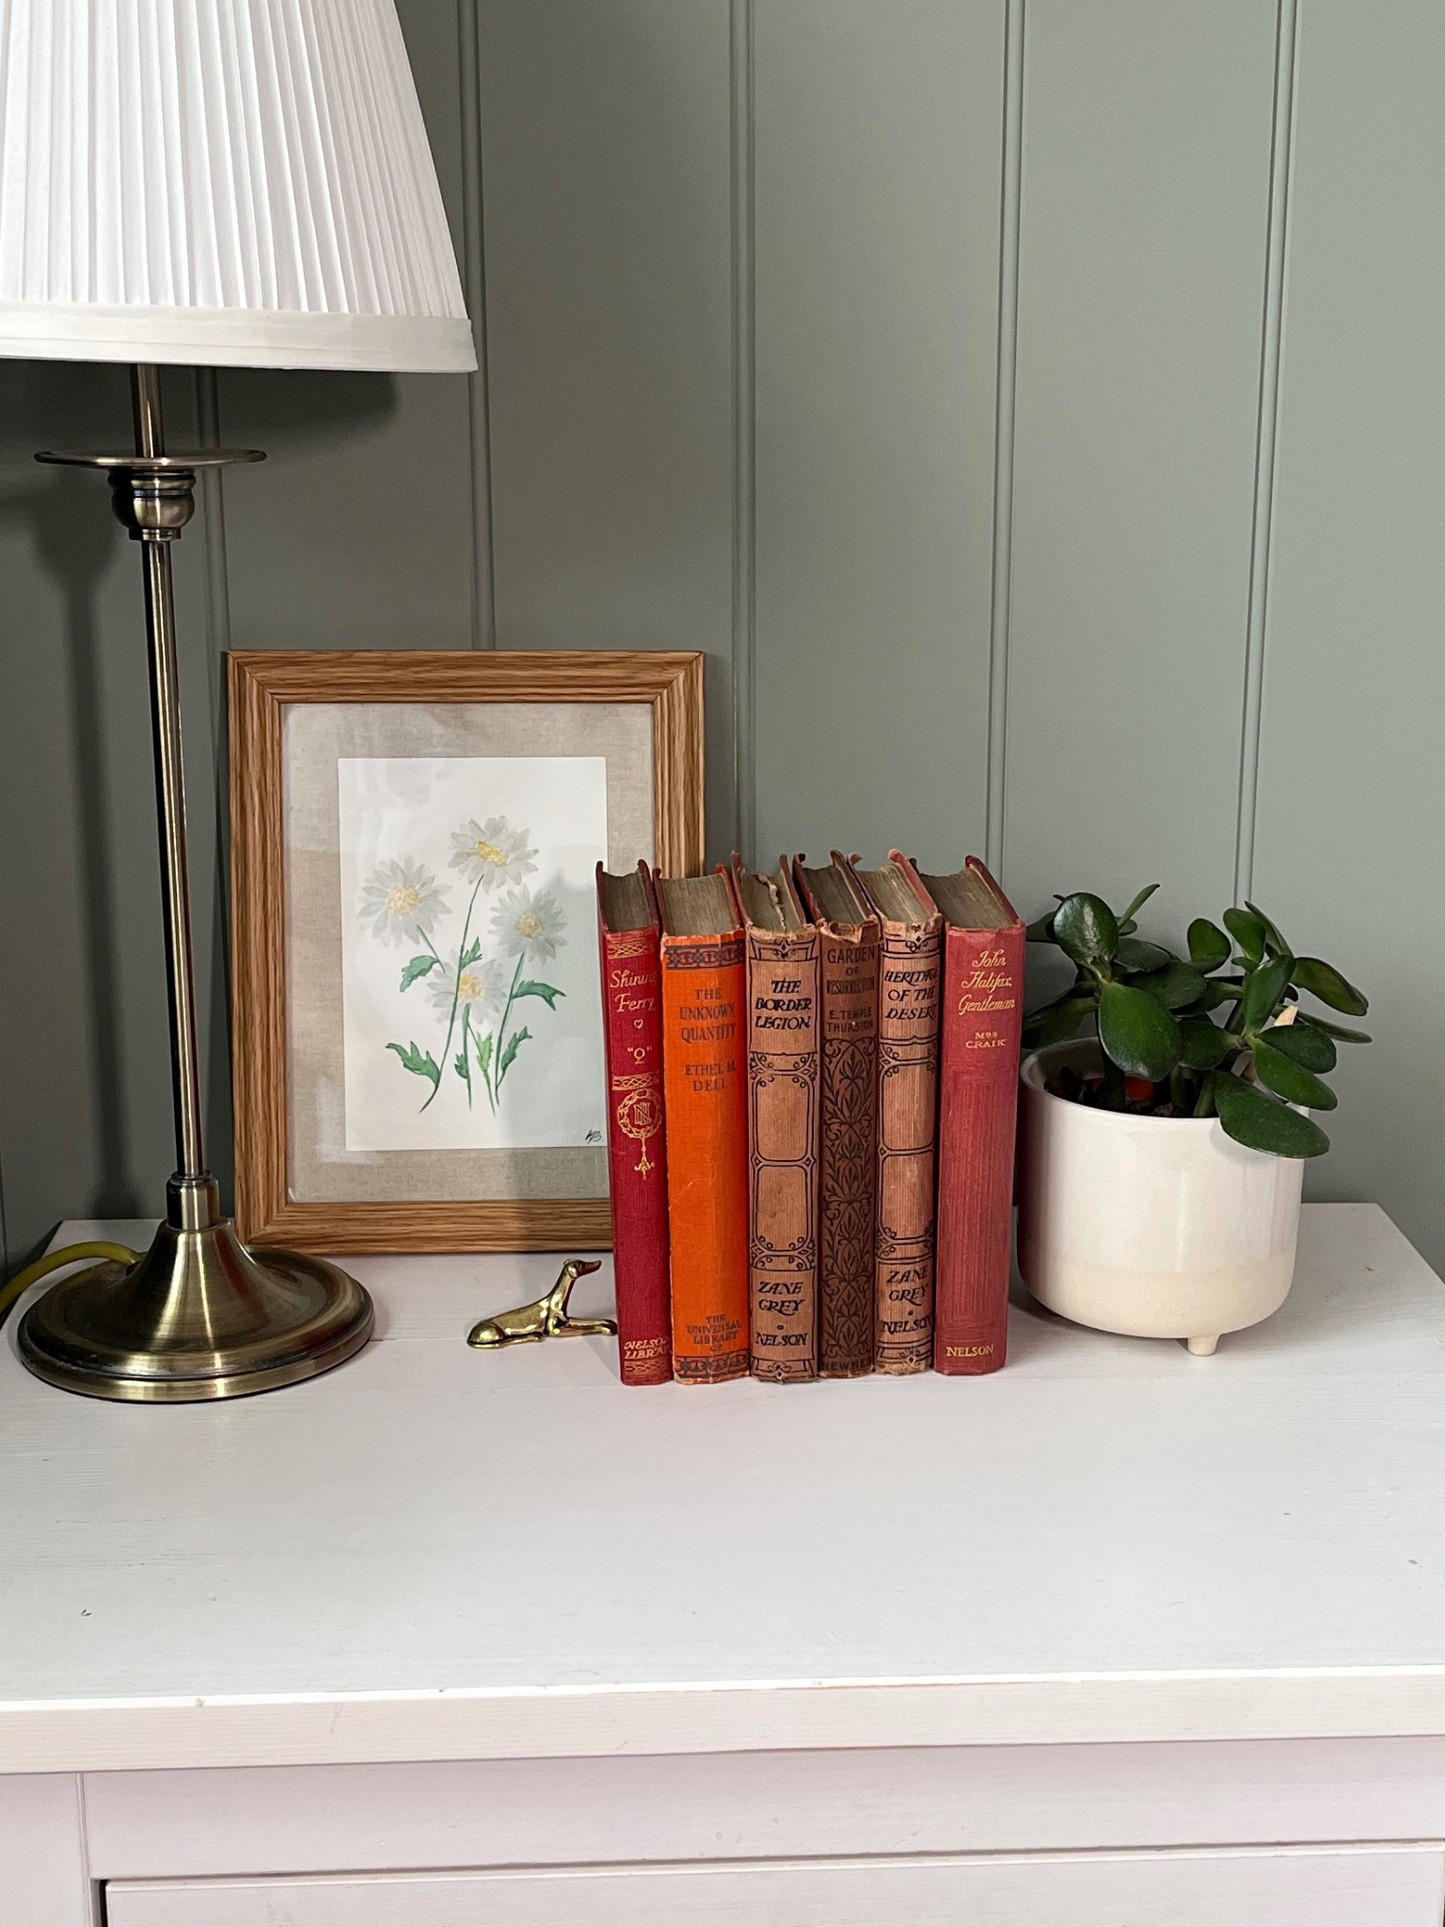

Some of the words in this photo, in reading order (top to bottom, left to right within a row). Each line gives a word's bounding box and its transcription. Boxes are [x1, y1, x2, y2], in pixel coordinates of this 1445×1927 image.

[827, 945, 875, 964] GARDEN
[971, 948, 1006, 968] John
[846, 966, 859, 976] OF
[771, 978, 801, 994] THE
[888, 989, 911, 1001] OF
[914, 986, 936, 1001] THE
[694, 988, 722, 1000] THE
[614, 992, 656, 1013] Ferry
[755, 998, 812, 1011] BORDER
[958, 994, 1015, 1016] Gentleman
[680, 1003, 735, 1020] UNKNOWN
[885, 1003, 938, 1020] DESERT
[755, 1016, 811, 1030] LEGION
[826, 1020, 873, 1033] THURSTON
[681, 1023, 736, 1043] QUANTITY
[965, 1039, 1007, 1049] CRAIK
[685, 1063, 724, 1076] ETHEL
[693, 1079, 726, 1091] DELL
[887, 1265, 930, 1284] ZANE
[758, 1282, 803, 1295] ZANE
[889, 1283, 929, 1306] GREY
[758, 1299, 805, 1316] GREY
[756, 1333, 808, 1347] NELSON
[946, 1345, 994, 1357] NELSON
